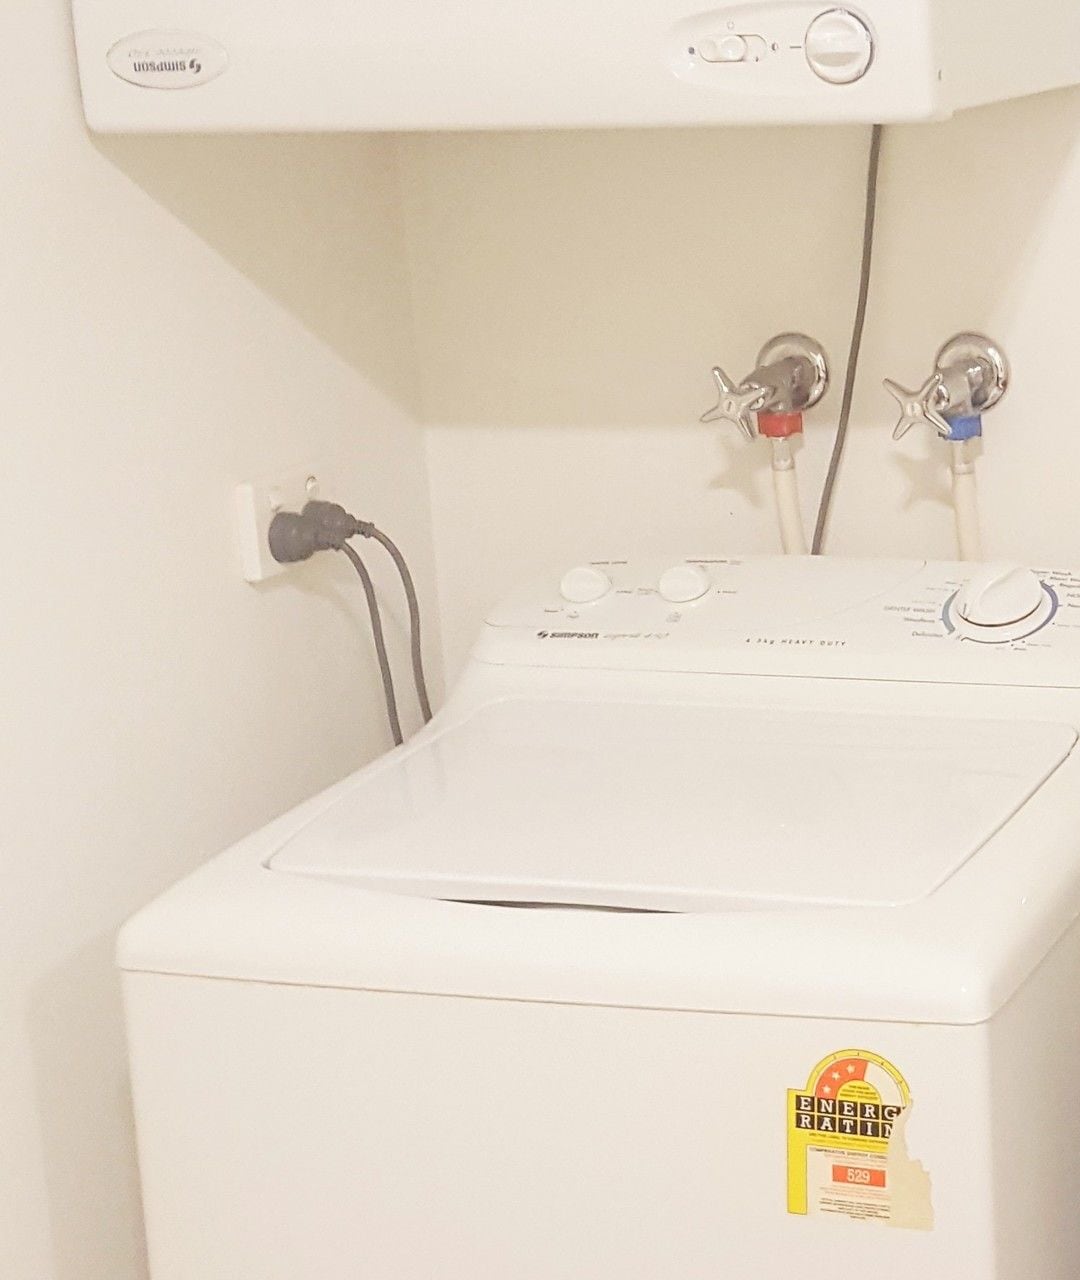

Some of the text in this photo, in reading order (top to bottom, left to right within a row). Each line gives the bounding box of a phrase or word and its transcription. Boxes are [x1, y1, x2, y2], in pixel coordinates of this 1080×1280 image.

[780, 638, 814, 646] HEAVY
[819, 639, 847, 647] DUTY
[799, 1096, 898, 1120] ENERG
[799, 1115, 893, 1138] RATIN
